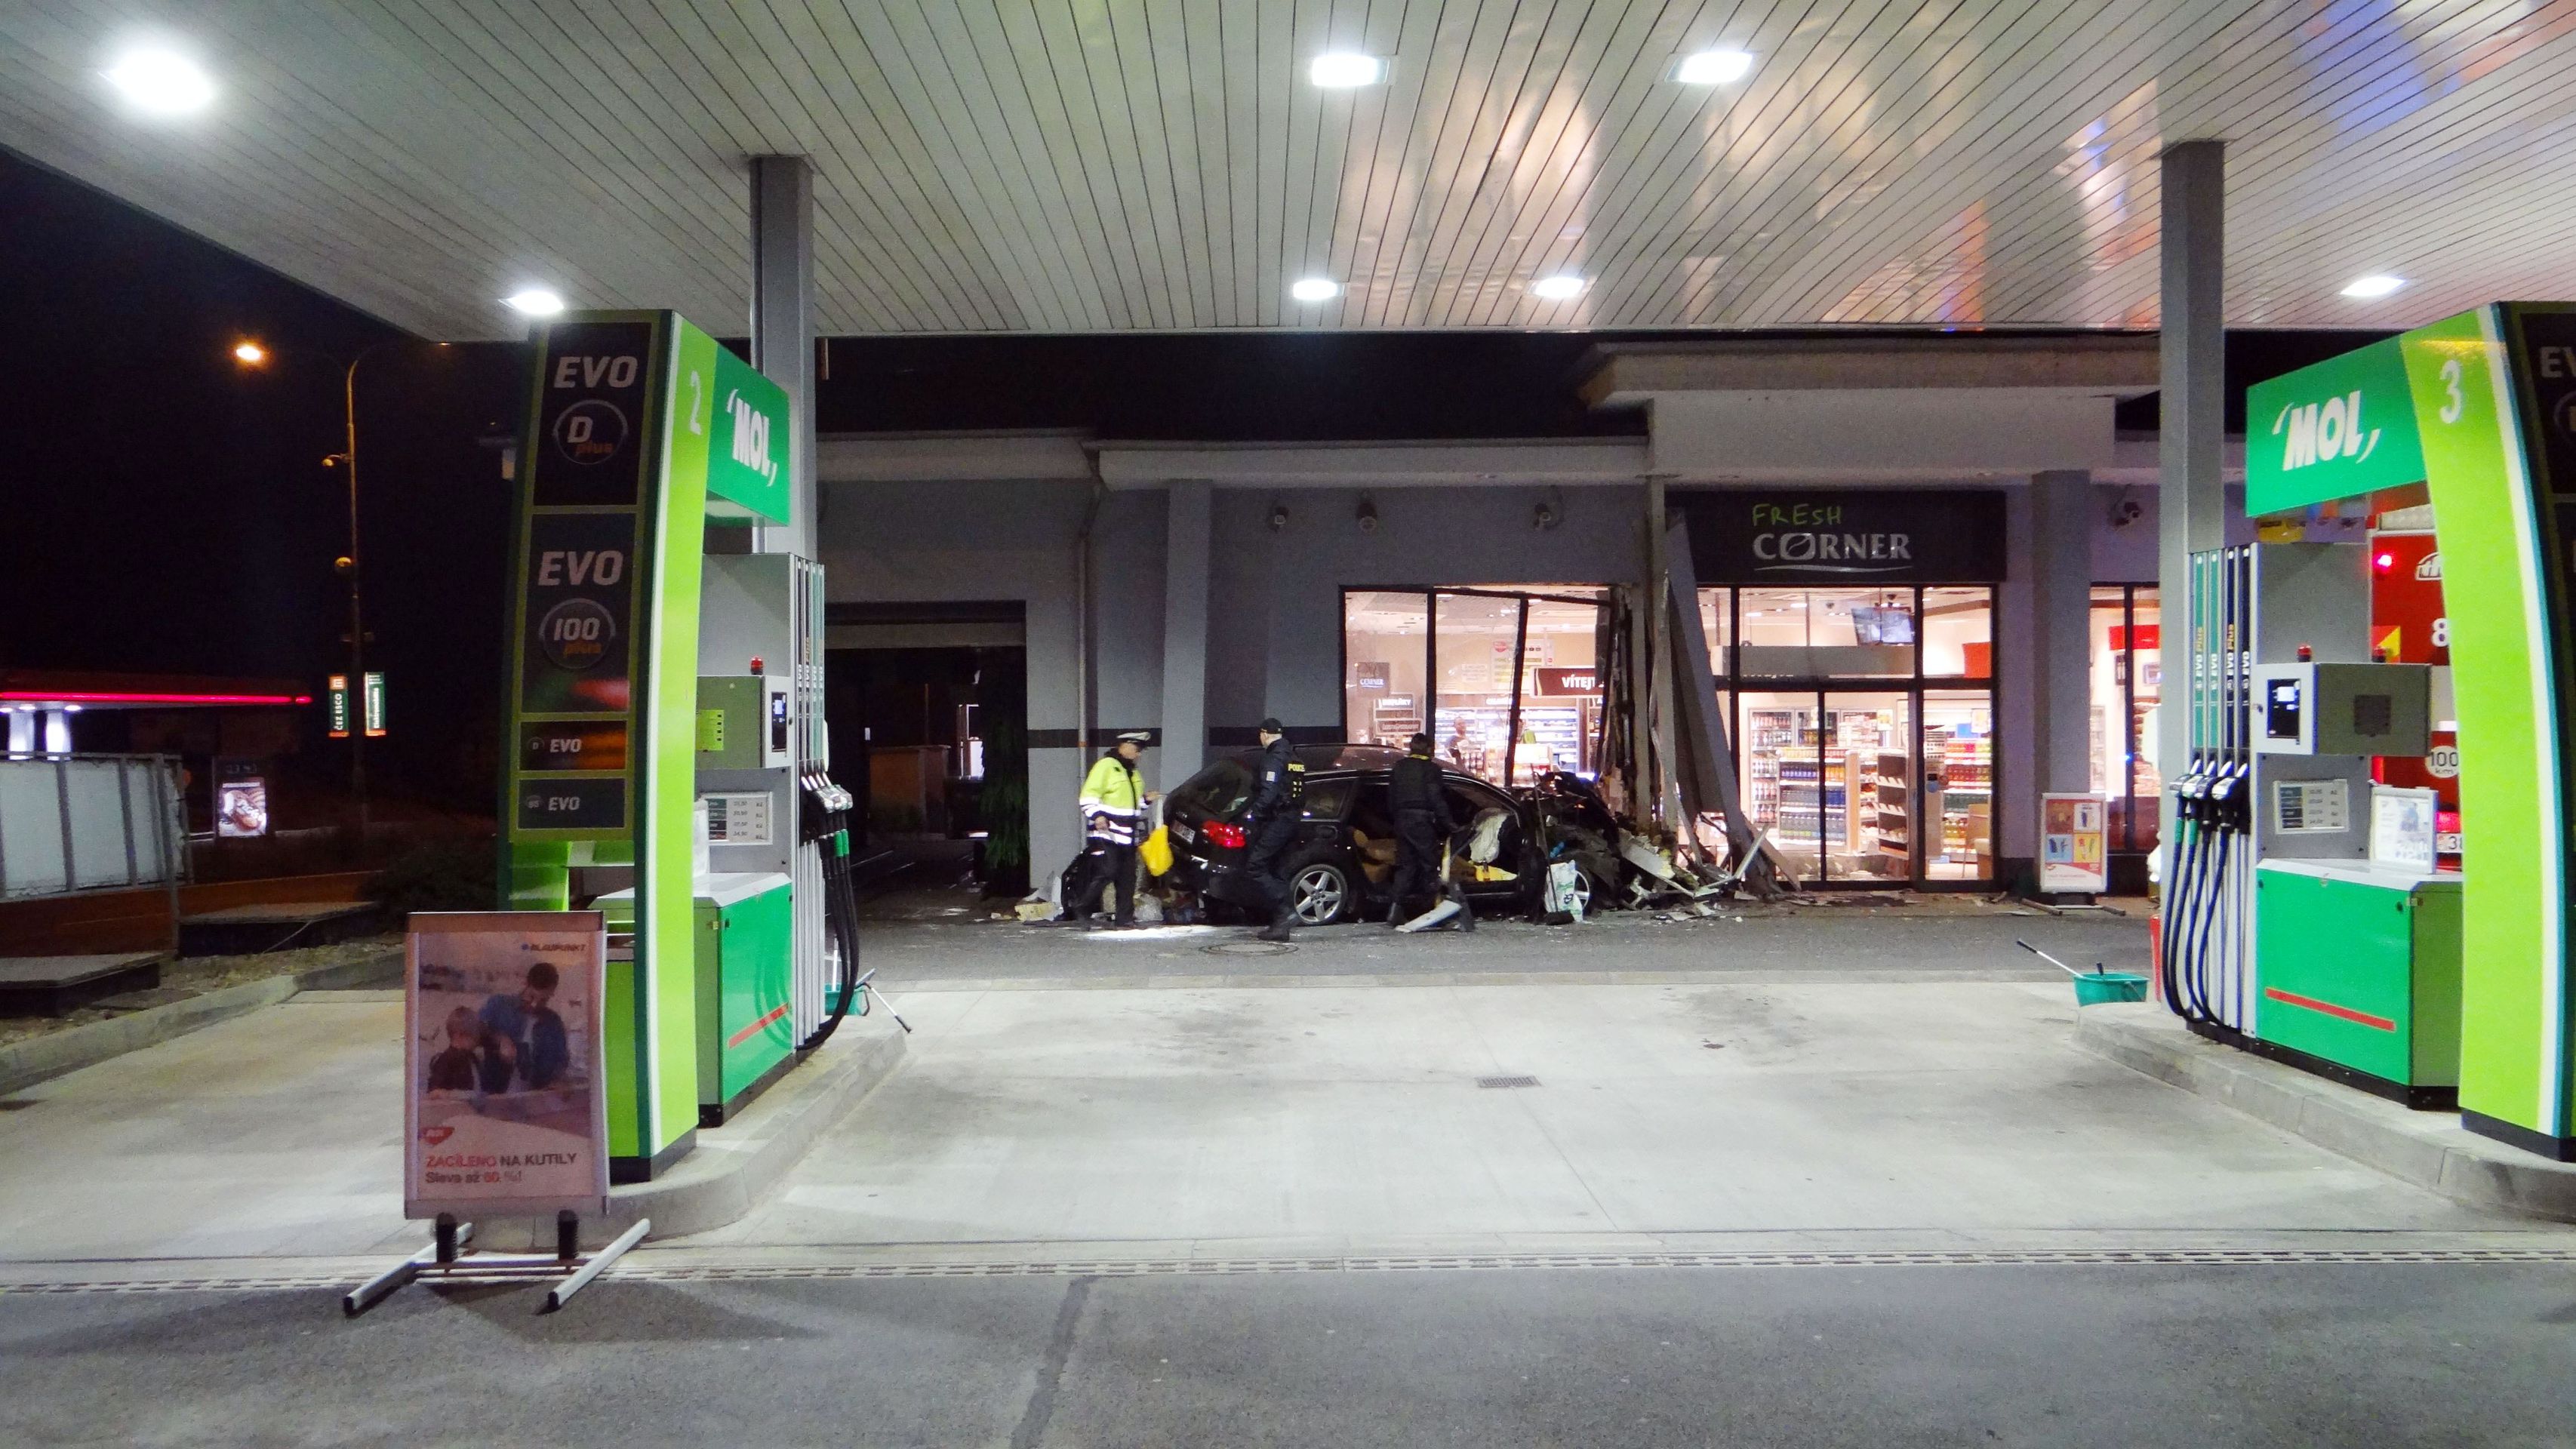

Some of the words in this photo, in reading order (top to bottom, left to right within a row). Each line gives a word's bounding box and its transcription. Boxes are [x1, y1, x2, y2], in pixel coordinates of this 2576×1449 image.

[554, 355, 638, 389] EVO
[690, 371, 702, 435] 2
[2439, 359, 2463, 424] 3
[568, 417, 593, 444] D
[729, 392, 774, 482] MOL
[2273, 390, 2380, 472] MOL
[1752, 503, 1842, 526] FRESH
[1752, 532, 1912, 561] CORNER
[538, 550, 623, 586] EVO
[553, 618, 600, 641] 100
[1562, 674, 1604, 690] VÍTEJT
[549, 738, 582, 753] EVO
[2427, 752, 2459, 767] 100
[548, 796, 580, 811] EVO
[500, 1155, 521, 1167] NA
[525, 1152, 577, 1167] KUTILY
